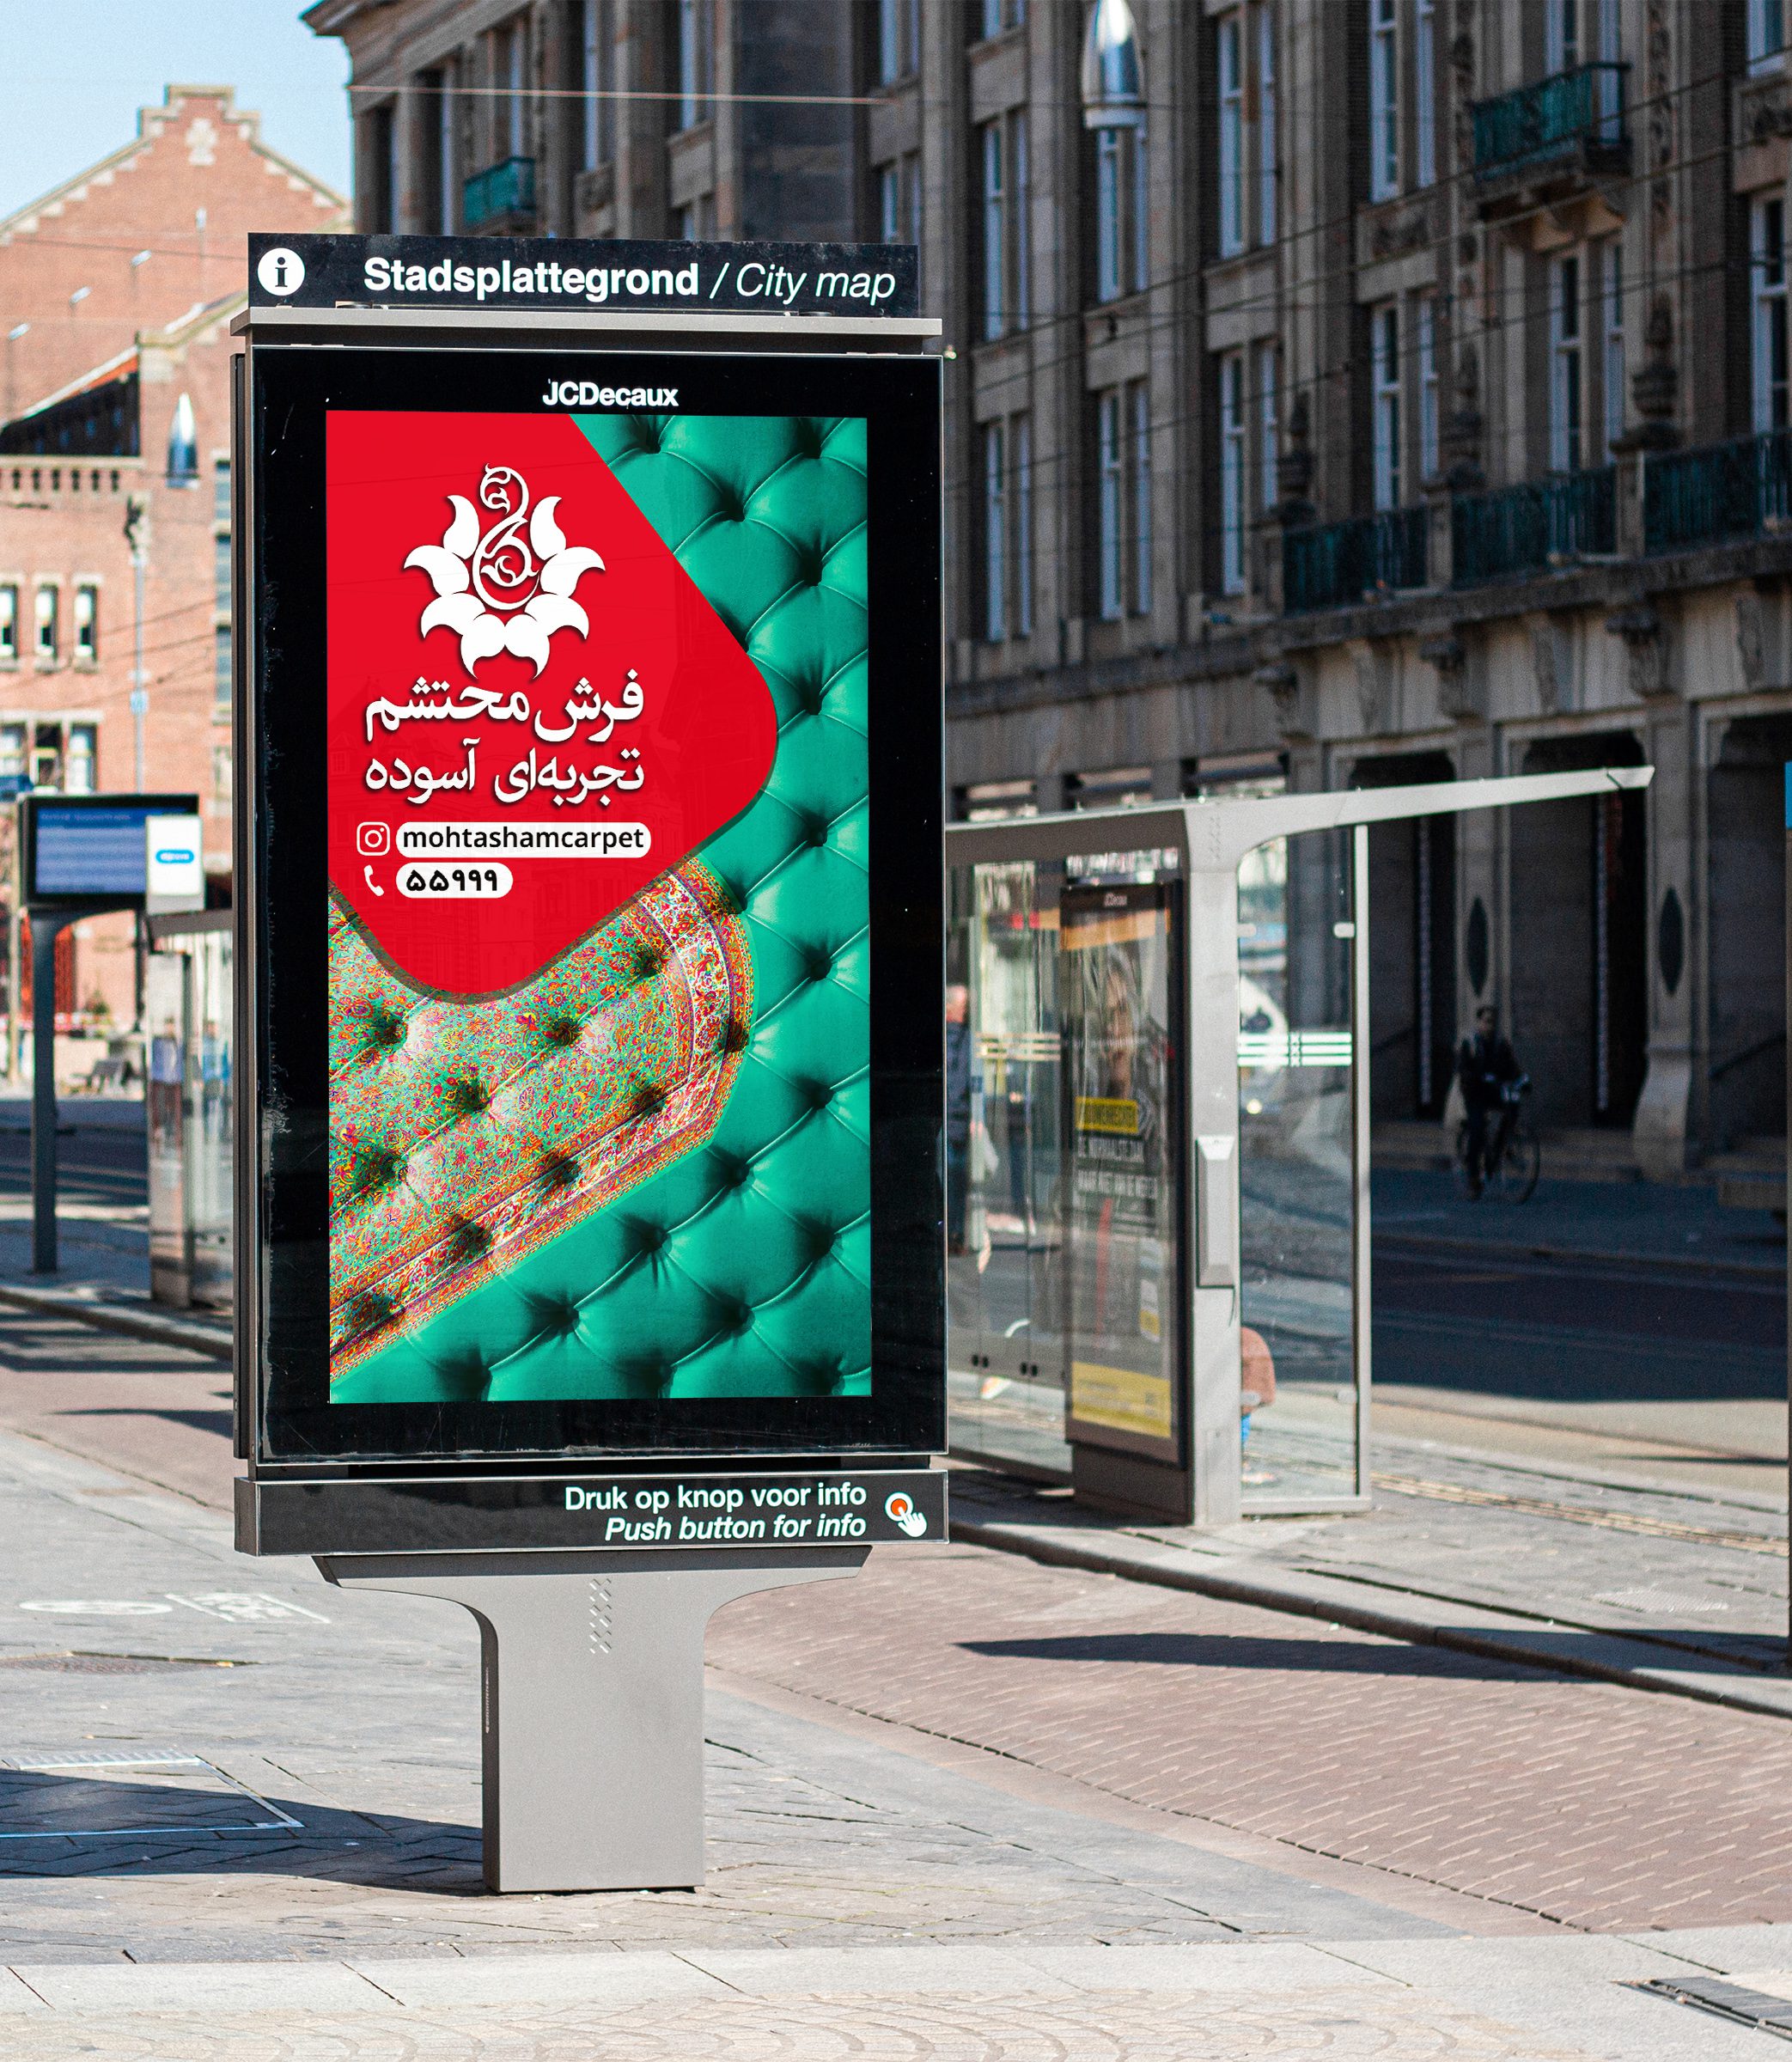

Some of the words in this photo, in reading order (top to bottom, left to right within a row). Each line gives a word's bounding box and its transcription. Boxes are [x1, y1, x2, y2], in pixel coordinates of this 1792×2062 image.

[363, 256, 698, 303] Stadsplattegrond
[736, 262, 808, 304] City
[815, 271, 896, 304] map
[542, 380, 680, 406] JCDecaux
[365, 676, 530, 742] محتشم
[533, 668, 644, 742] فرش
[365, 737, 481, 804] آسوده
[402, 826, 644, 855] mohtashamcarpet
[405, 869, 497, 892] ۵۵۹۹۹
[565, 1485, 628, 1510] Druk
[635, 1491, 670, 1515] op
[678, 1485, 743, 1513] knop
[751, 1487, 812, 1507] voor
[818, 1481, 867, 1506] info
[605, 1516, 672, 1541] Push
[678, 1516, 765, 1540] button
[773, 1514, 813, 1538] for
[816, 1512, 867, 1537] info
